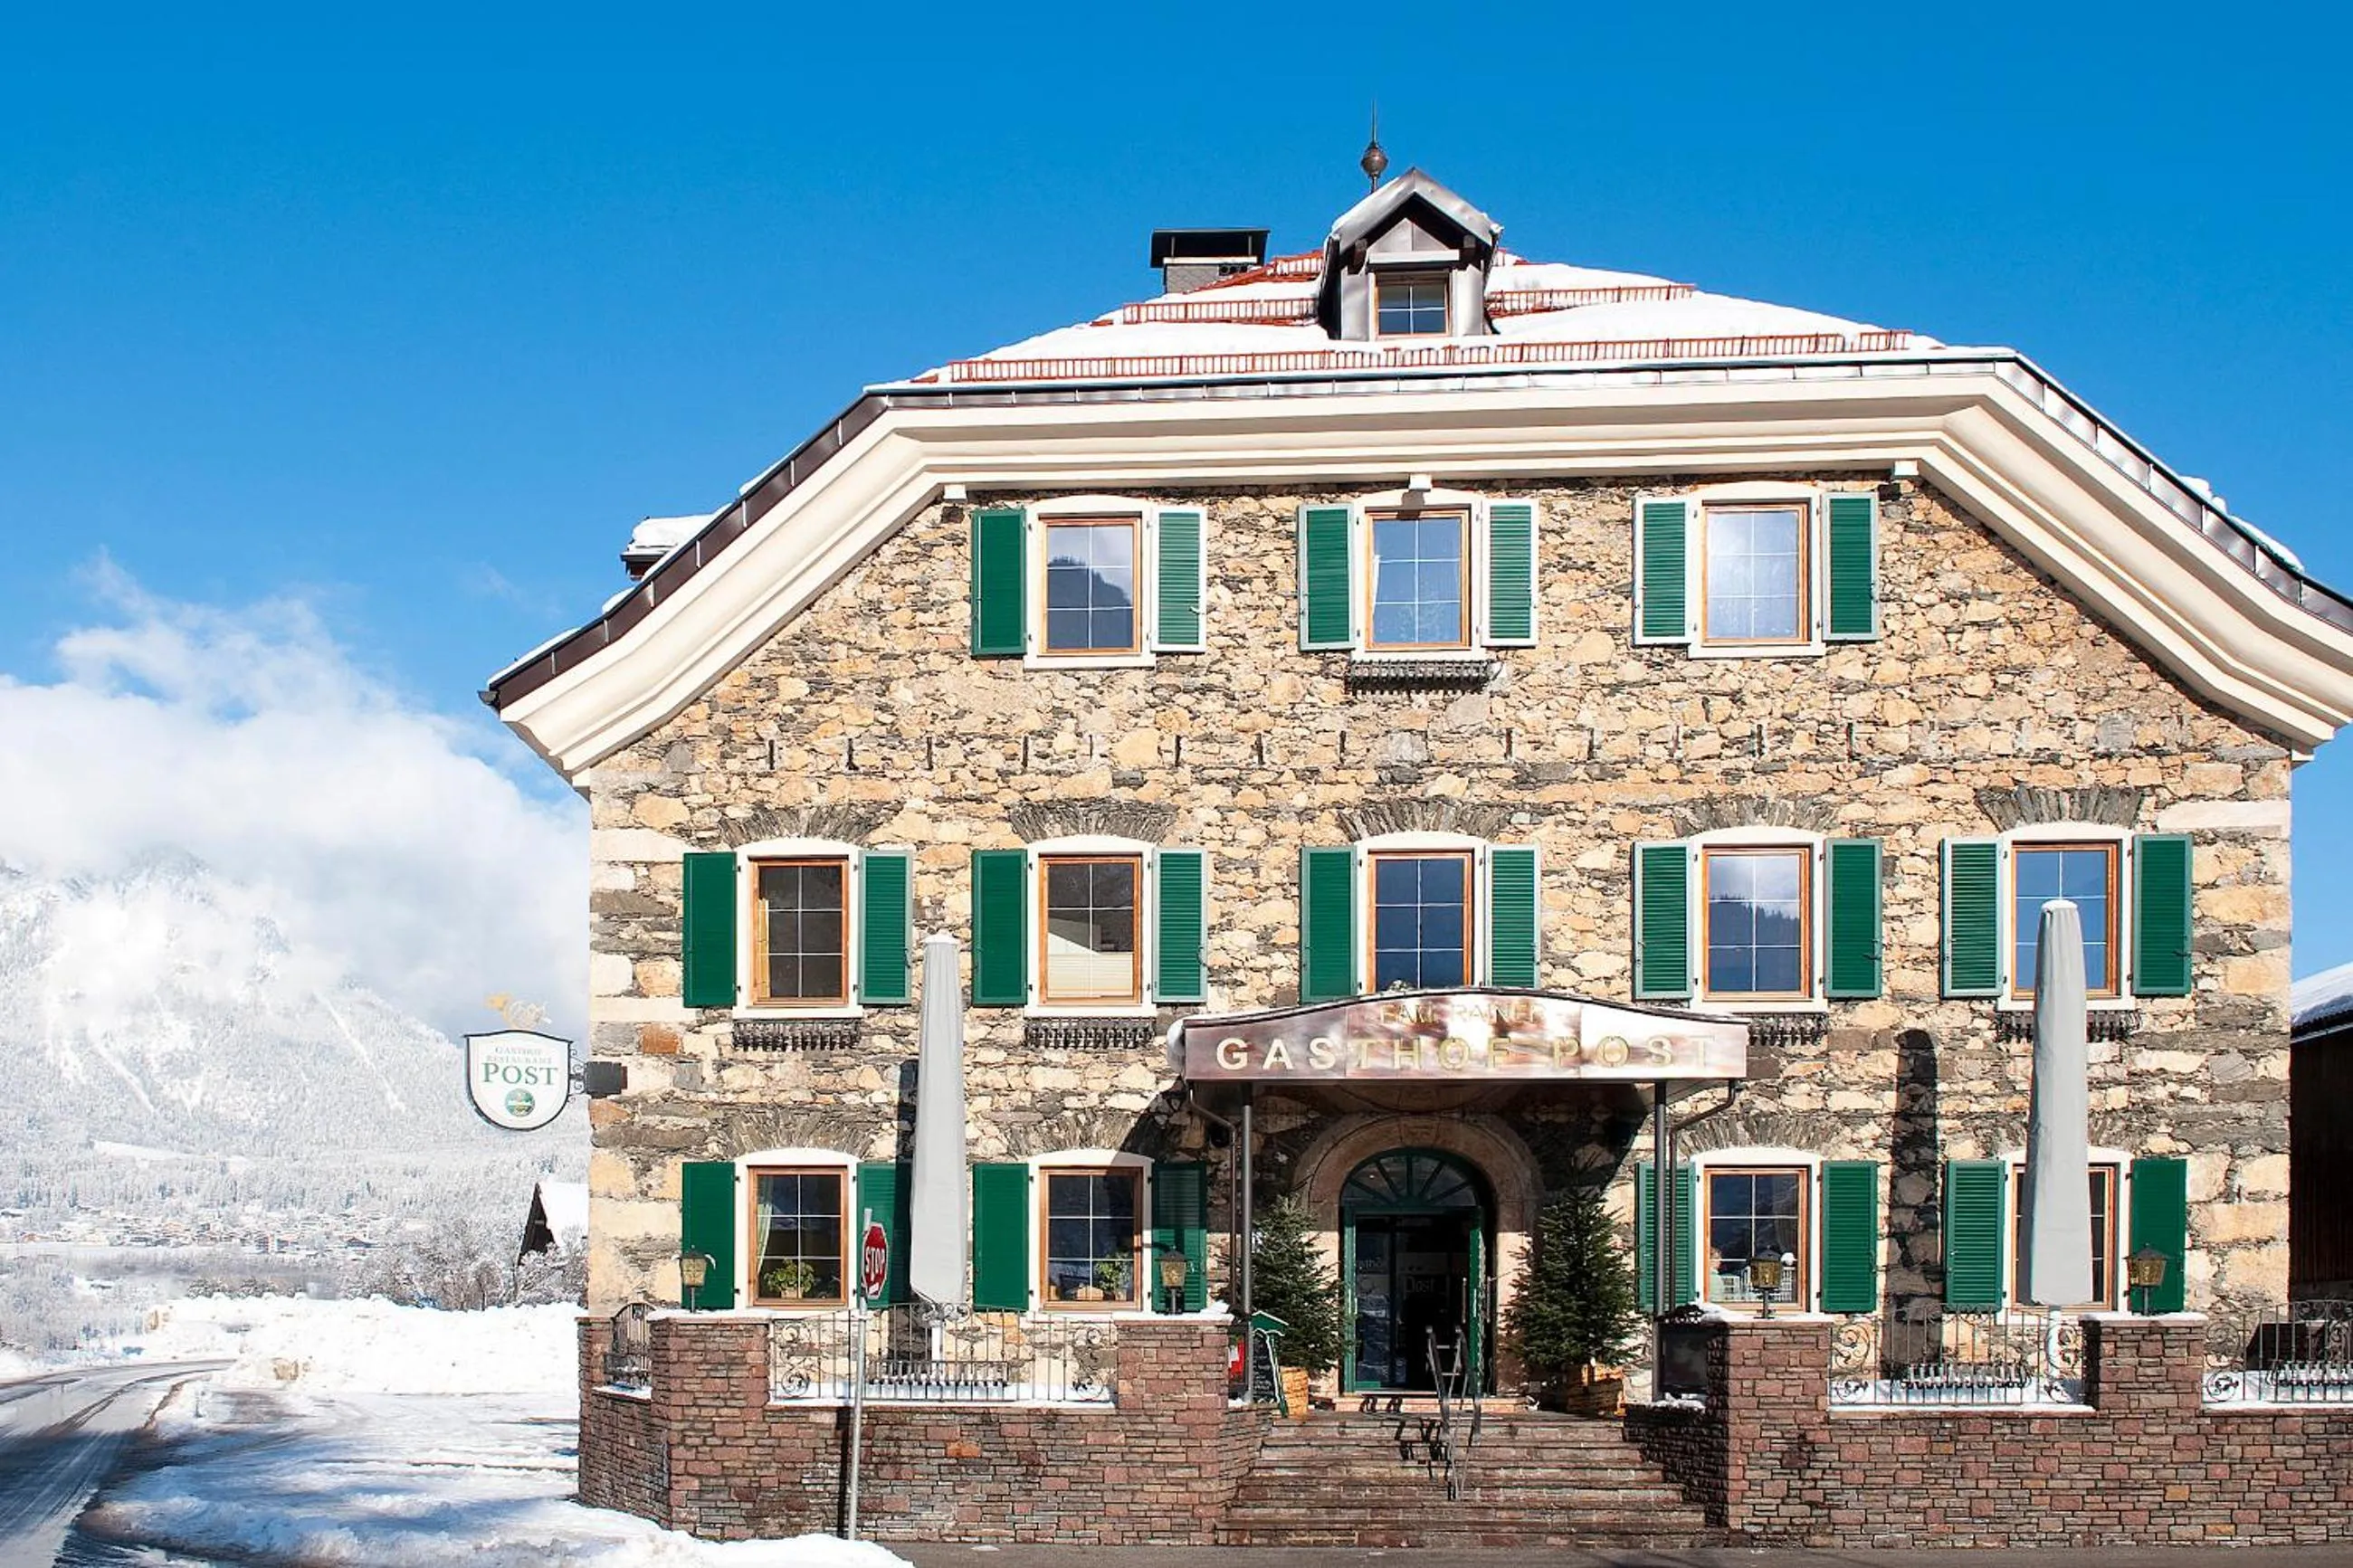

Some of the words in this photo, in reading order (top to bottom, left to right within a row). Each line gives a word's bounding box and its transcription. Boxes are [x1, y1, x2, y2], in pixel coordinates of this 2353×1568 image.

[1216, 1037, 1510, 1070] GASTHOF
[1553, 1035, 1716, 1068] POST
[481, 1062, 558, 1086] POST
[865, 1246, 885, 1282] STOP
